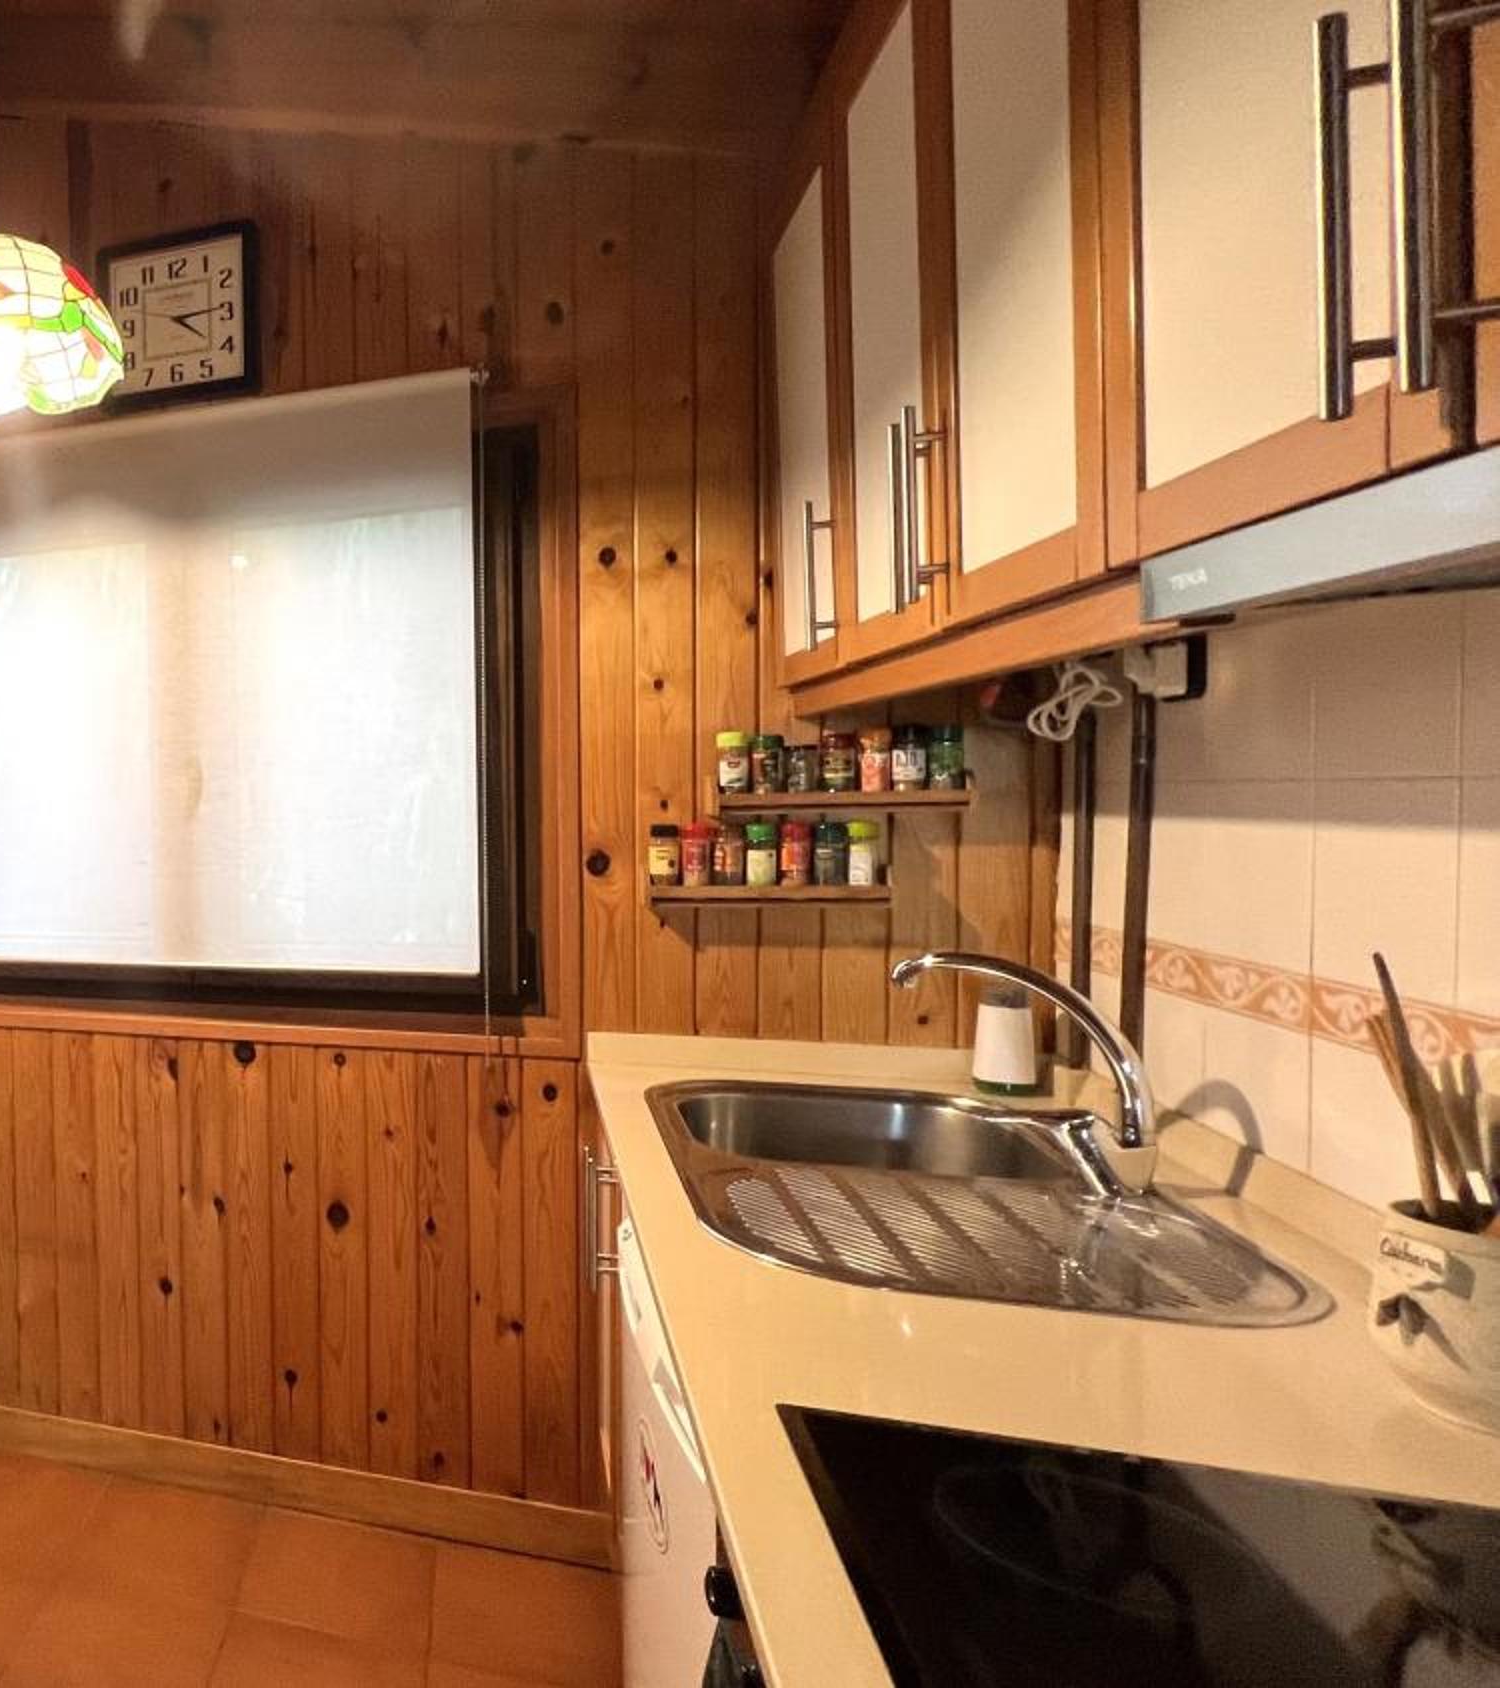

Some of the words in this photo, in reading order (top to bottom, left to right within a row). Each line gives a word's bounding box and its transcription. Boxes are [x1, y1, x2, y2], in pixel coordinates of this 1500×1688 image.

[167, 258, 187, 280] 12
[203, 255, 209, 272] 1
[142, 267, 154, 285] 11
[219, 269, 233, 289] 2
[119, 287, 138, 308] 10
[219, 302, 233, 321] 3
[122, 320, 135, 339] 9
[219, 336, 234, 353] 4
[124, 352, 135, 370] 8
[200, 358, 213, 378] 5
[144, 368, 154, 387] 7
[170, 364, 184, 383] 6
